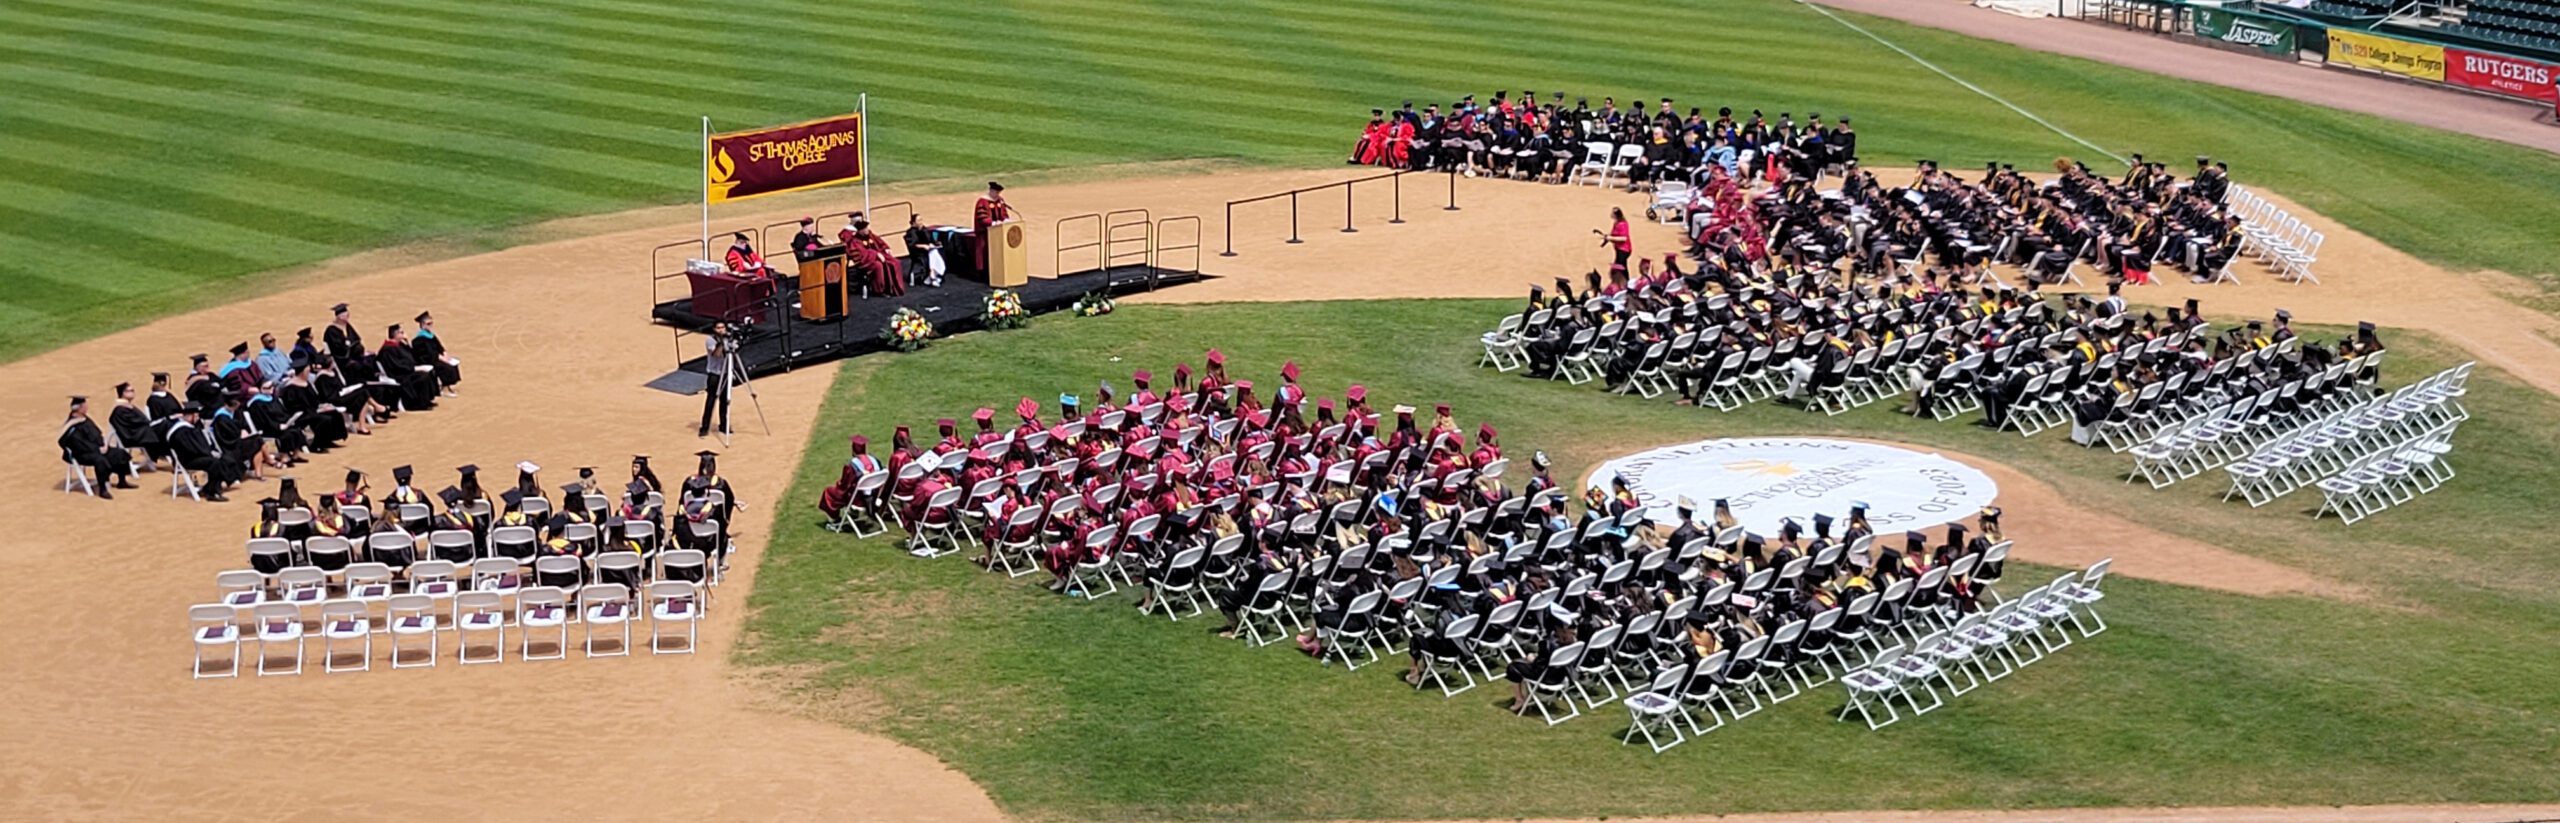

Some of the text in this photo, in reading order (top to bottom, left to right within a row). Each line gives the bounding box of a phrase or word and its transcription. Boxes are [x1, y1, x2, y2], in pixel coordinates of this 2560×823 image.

[2221, 17, 2281, 46] JASPERS
[2353, 44, 2368, 58] 529
[2369, 46, 2390, 64] College
[2392, 51, 2414, 69] Savings
[2416, 55, 2442, 72] Program
[2464, 55, 2549, 85] RUTGERS
[2491, 79, 2523, 92] ATHLETICS
[764, 139, 808, 159] THOMAS
[808, 130, 855, 152] AQUINAS
[782, 151, 827, 171] COLLEGE
[1917, 468, 1968, 513] OF 2023
